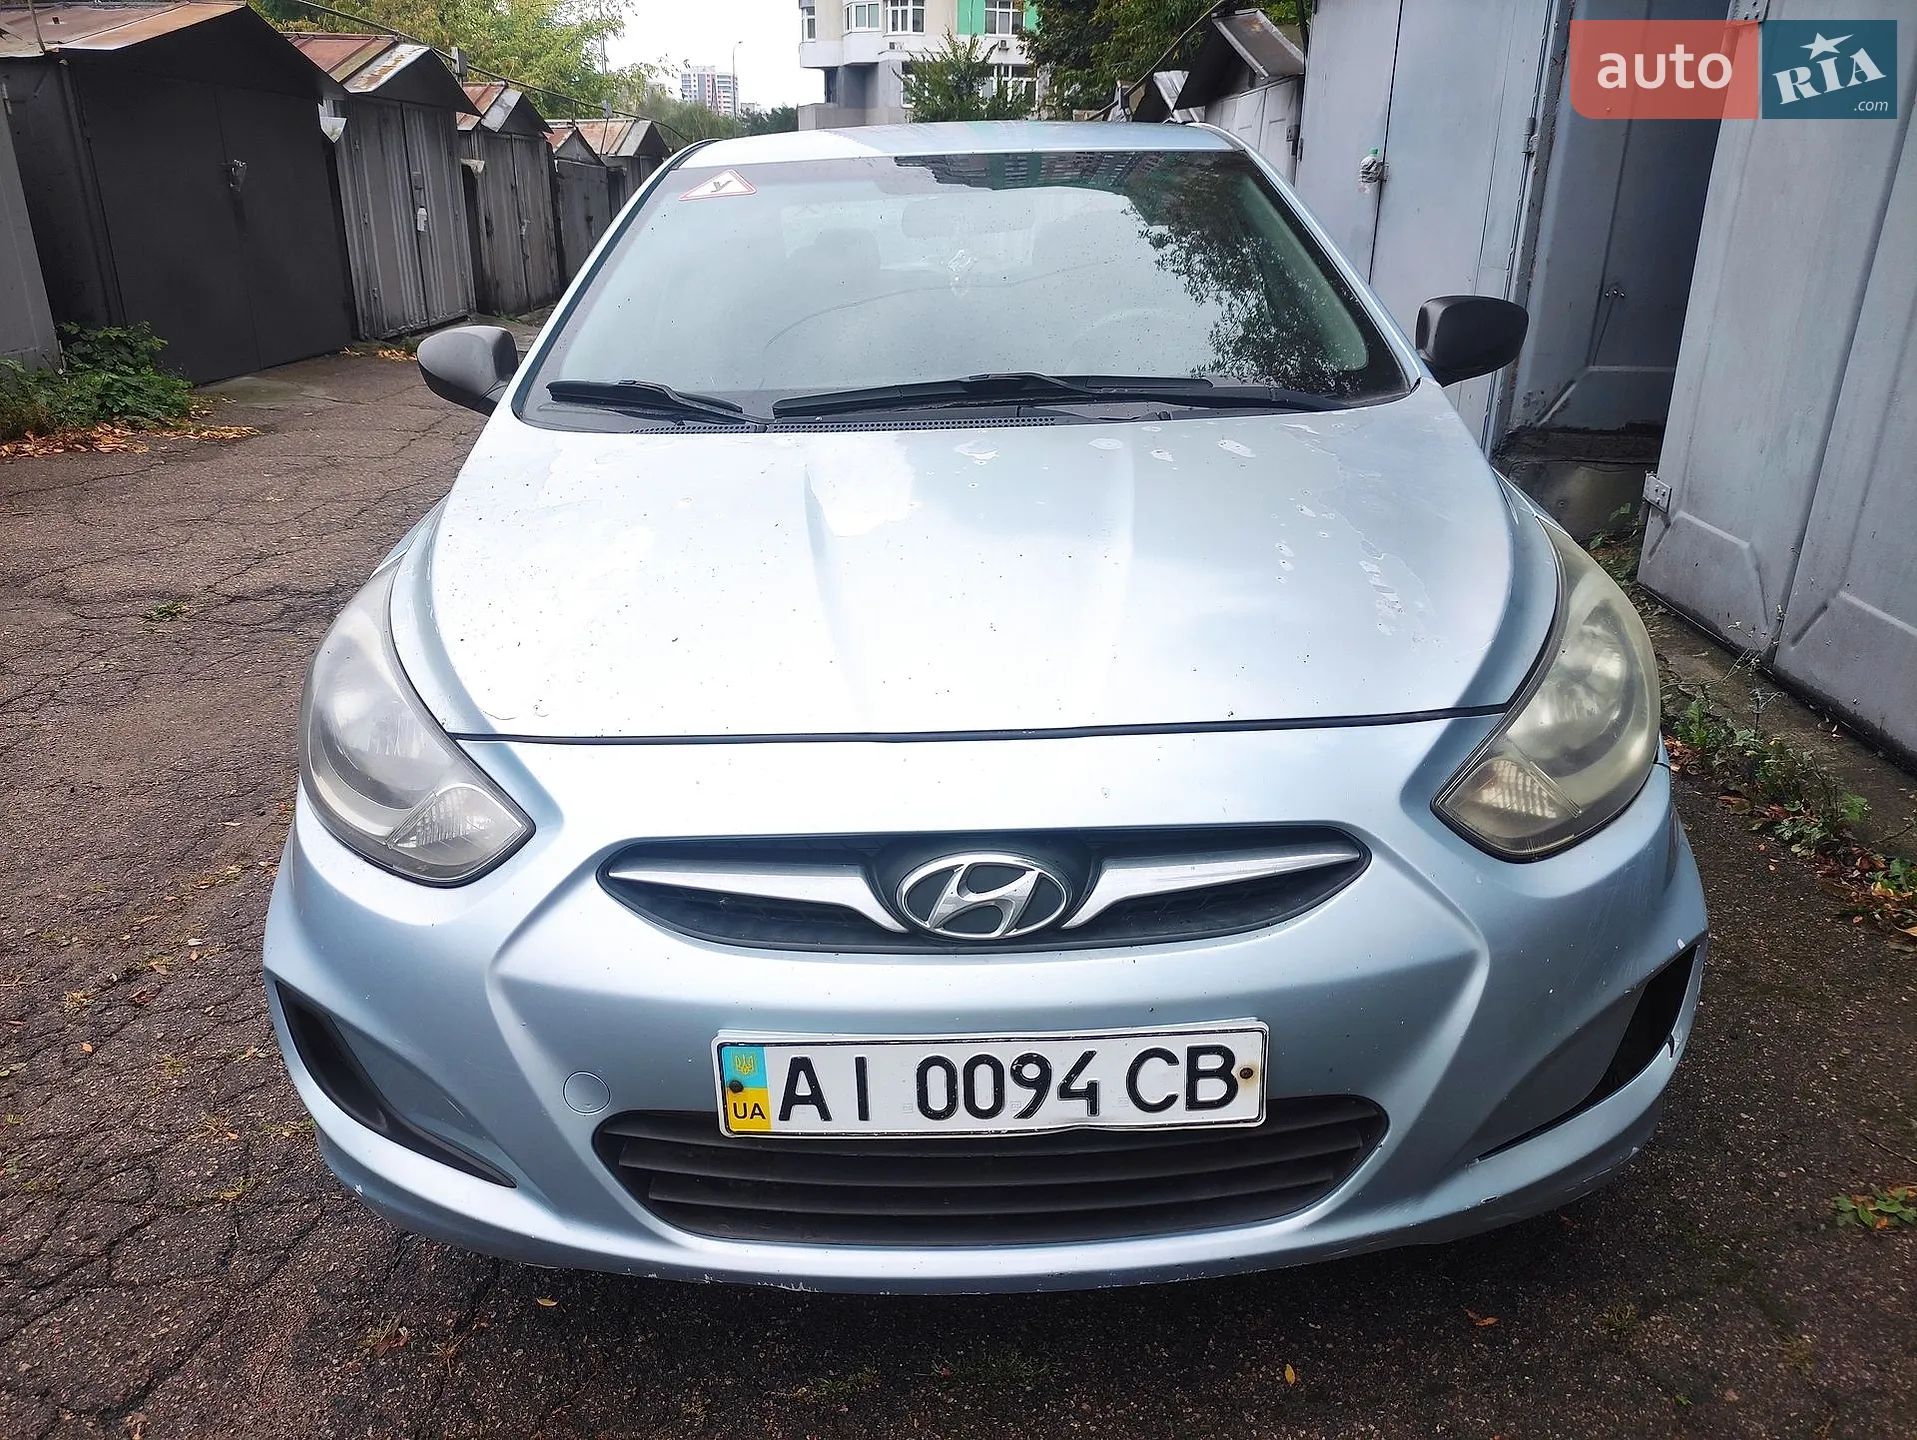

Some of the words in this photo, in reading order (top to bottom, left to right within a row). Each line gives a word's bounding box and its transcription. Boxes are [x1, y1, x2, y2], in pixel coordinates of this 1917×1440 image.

[779, 1056, 870, 1121] AI
[916, 1050, 1100, 1121] 0094
[1125, 1044, 1239, 1114] CB
[733, 1102, 766, 1120] UA
